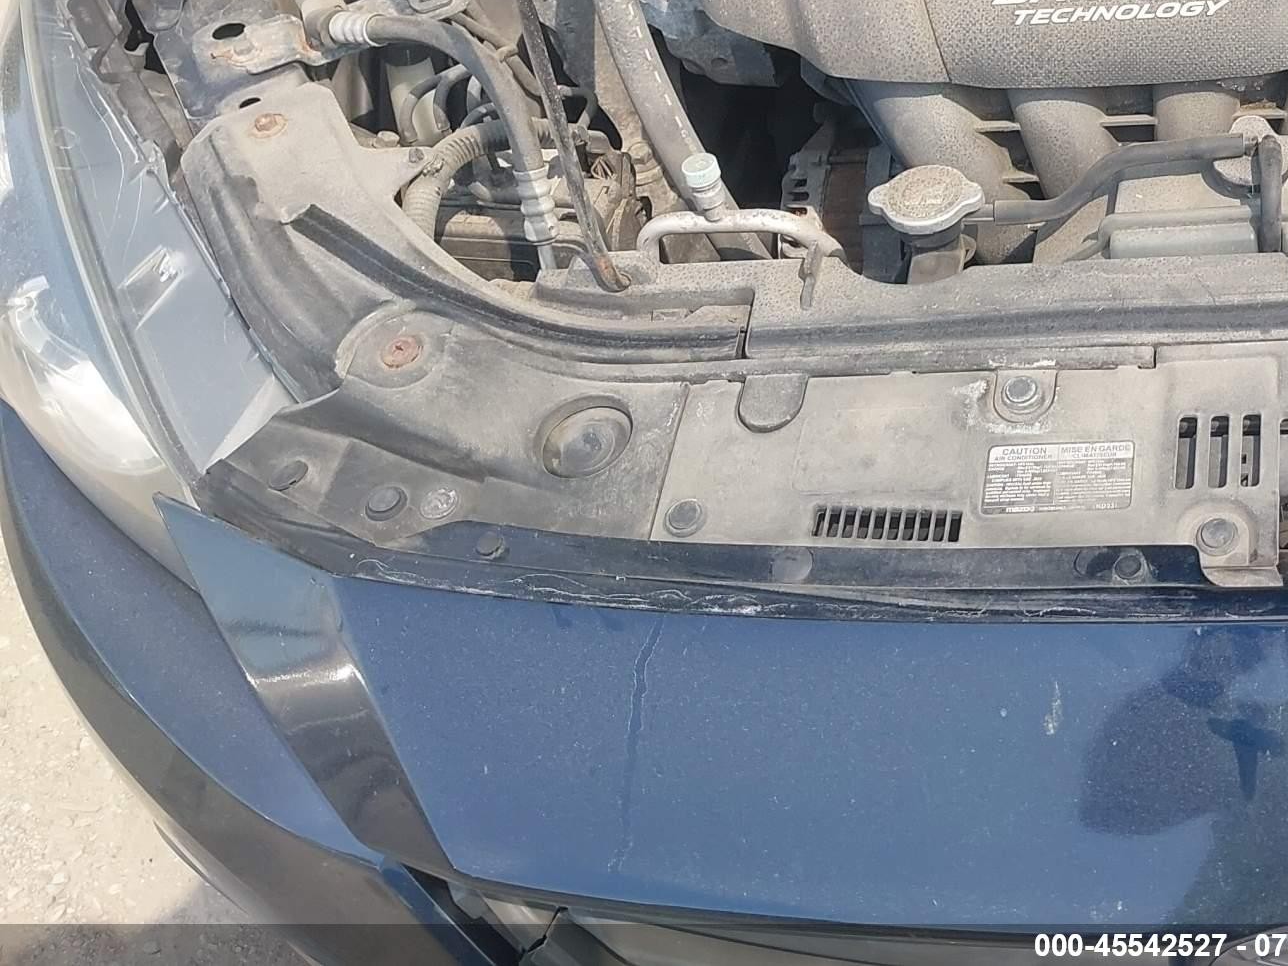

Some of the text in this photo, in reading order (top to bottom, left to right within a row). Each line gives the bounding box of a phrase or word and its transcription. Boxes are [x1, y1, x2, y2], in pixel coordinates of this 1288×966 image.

[1014, 0, 1230, 26] TECHNOLOGY
[1002, 447, 1048, 456] CAUTION
[1061, 444, 1131, 454] MISE EN GARDE
